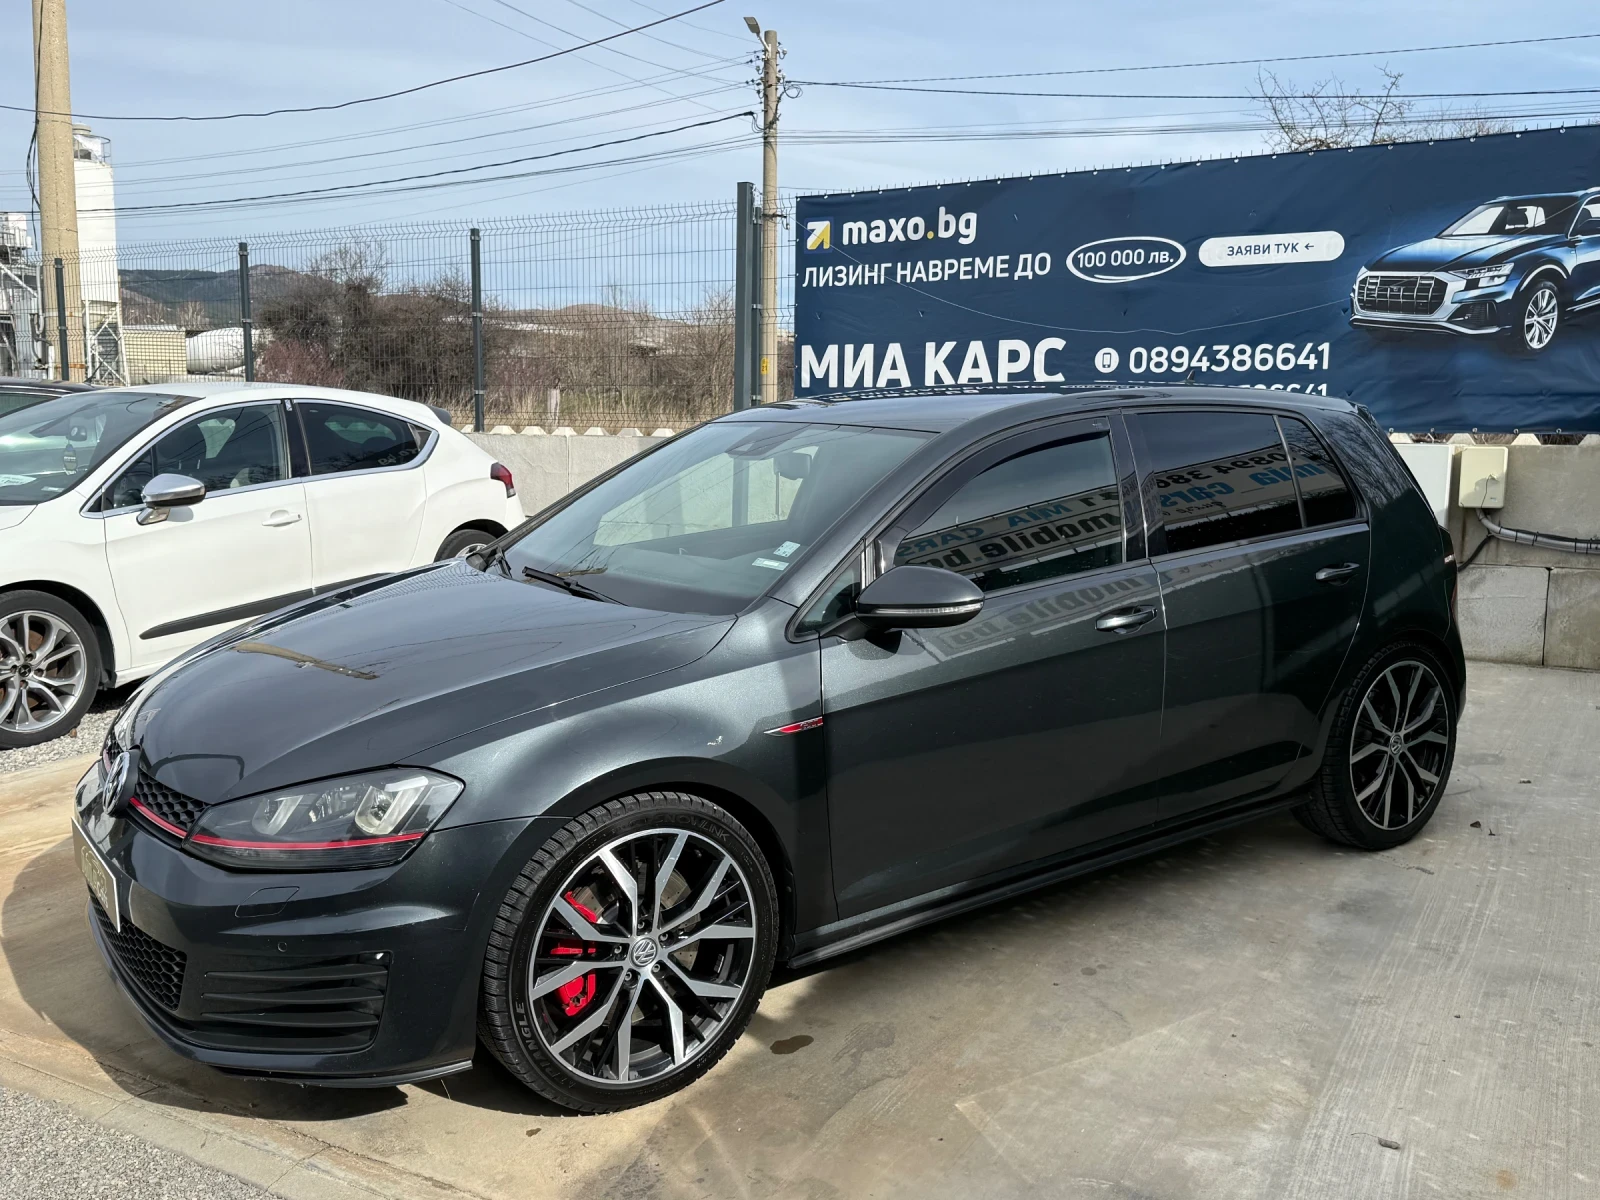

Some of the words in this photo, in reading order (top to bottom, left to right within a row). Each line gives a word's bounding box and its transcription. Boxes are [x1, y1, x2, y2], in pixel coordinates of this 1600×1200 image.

[842, 206, 978, 245] maxo.bg
[1077, 252, 1106, 268] 100
[1110, 248, 1145, 266] 000
[1148, 251, 1174, 265] лв.
[1226, 245, 1271, 257] ЗАЯВИ
[1274, 242, 1299, 254] ТУК
[802, 262, 892, 287] ЛИЗИНГ
[896, 255, 1010, 283] НАВРЕМЕ
[1014, 252, 1051, 280] ДО
[801, 342, 912, 388] МИА
[924, 337, 1067, 386] КАРС
[1128, 342, 1330, 374] 0894386641
